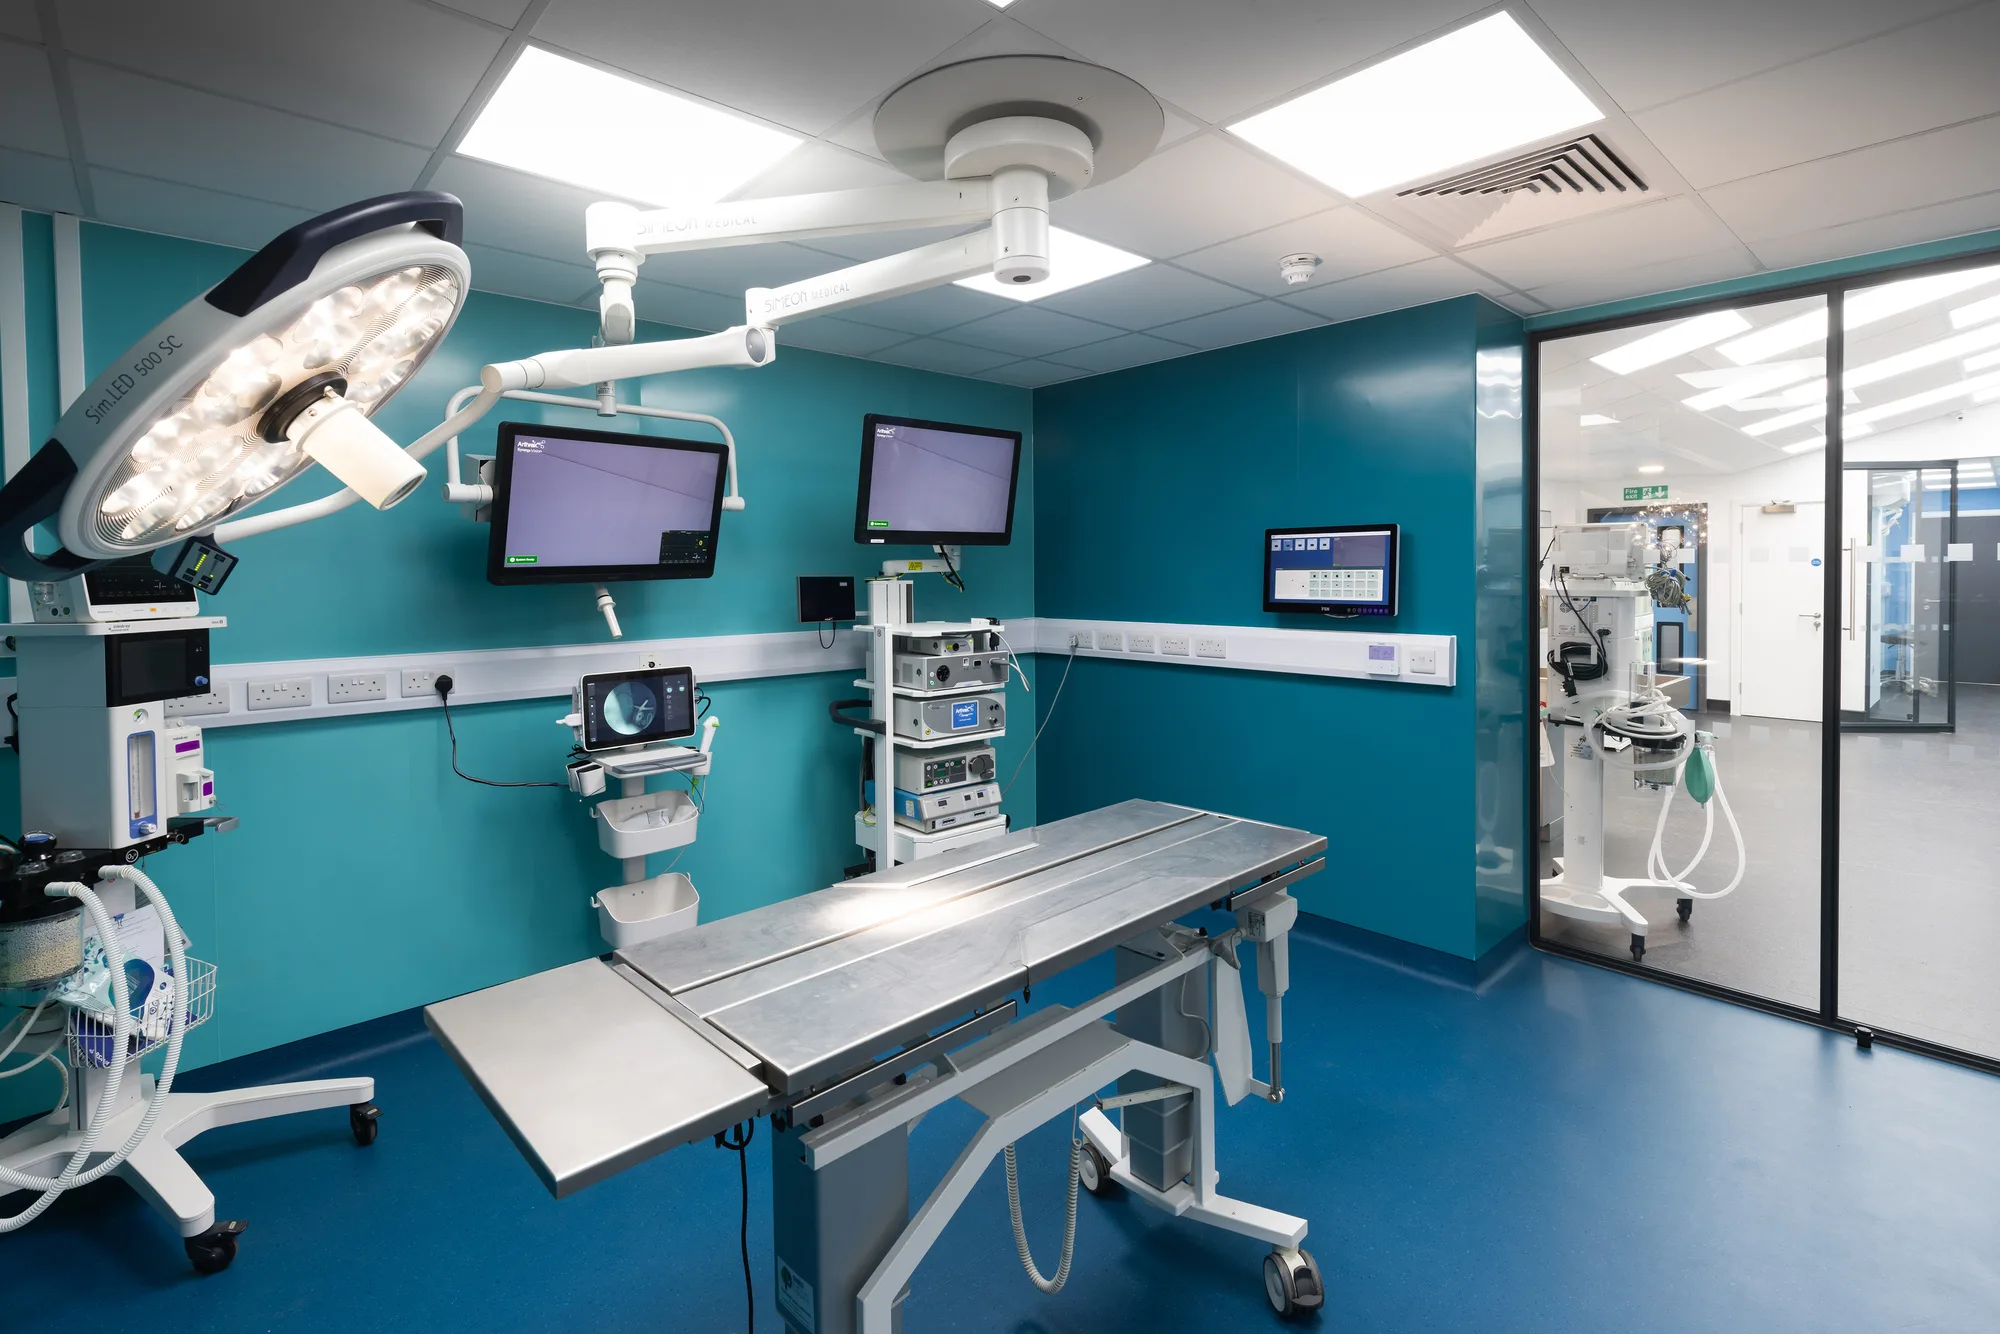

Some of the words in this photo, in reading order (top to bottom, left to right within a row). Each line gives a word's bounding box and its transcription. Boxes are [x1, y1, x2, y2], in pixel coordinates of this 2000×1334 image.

[764, 290, 807, 313] SIMEON
[811, 281, 850, 301] MEDICAL
[85, 373, 135, 424] Sim.LED
[133, 351, 162, 376] 500
[158, 335, 183, 356] SC
